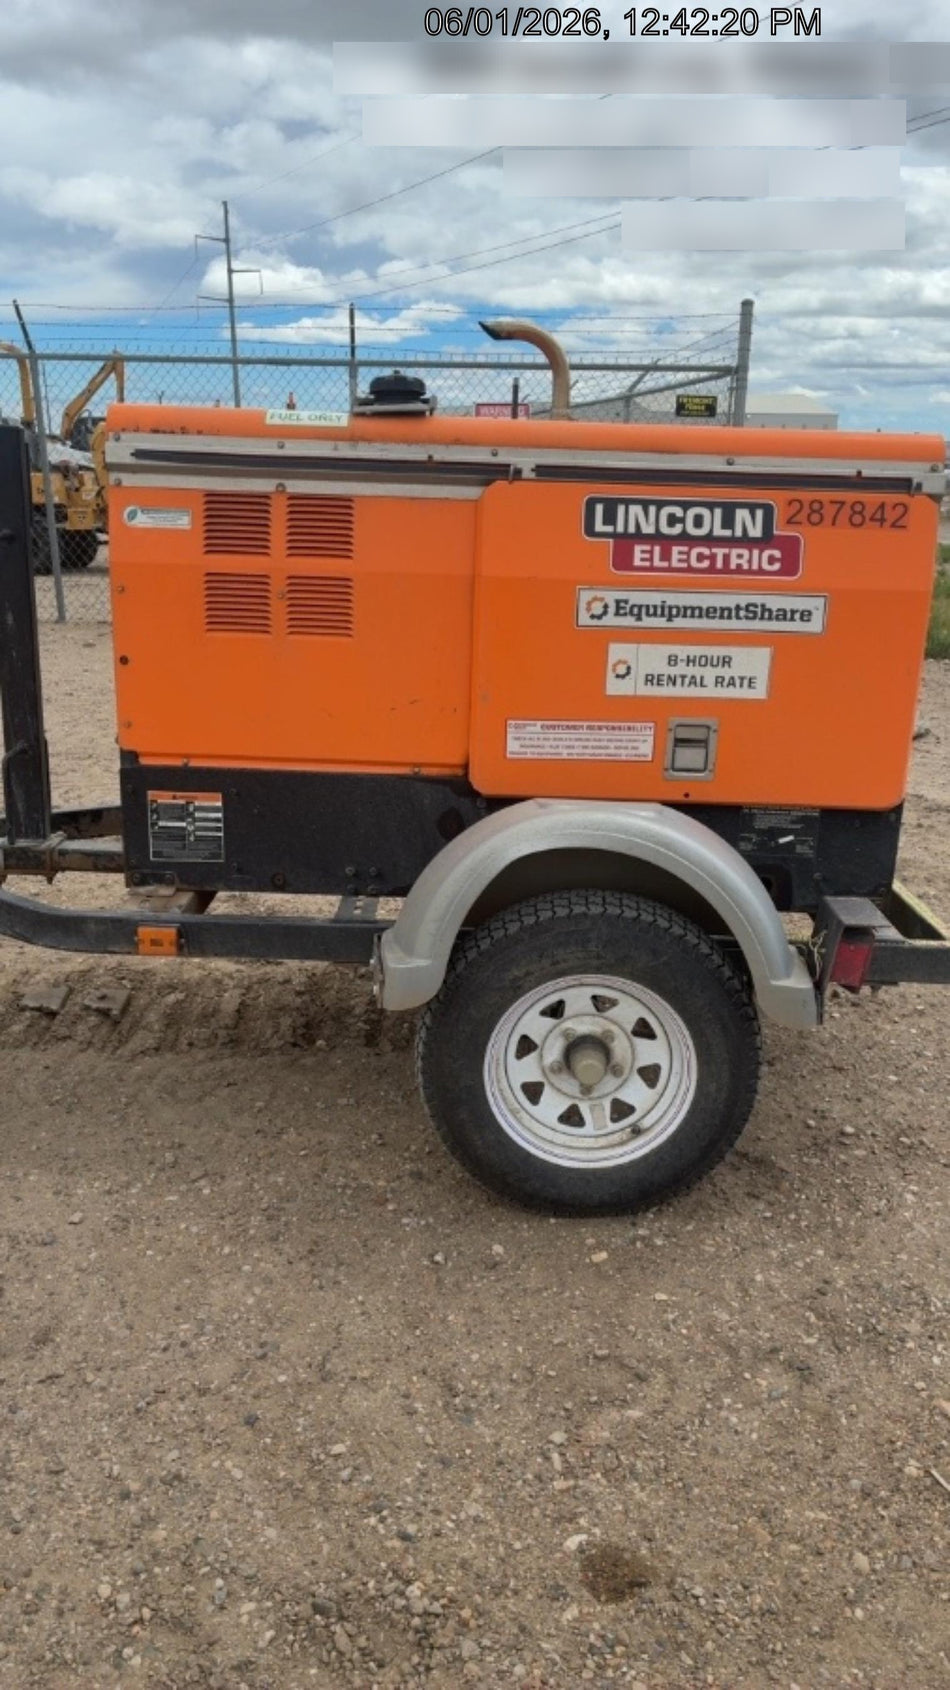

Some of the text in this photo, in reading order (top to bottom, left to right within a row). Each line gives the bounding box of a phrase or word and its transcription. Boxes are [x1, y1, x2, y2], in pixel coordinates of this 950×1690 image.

[270, 412, 343, 424] FUEL ONLY
[479, 405, 525, 417] WARNIG
[593, 502, 765, 538] LINCOLN
[785, 498, 909, 530] 287842
[632, 544, 782, 572] ELECTRIC
[667, 653, 733, 669] 8-HOUR
[644, 672, 758, 690] RENTAL RATE
